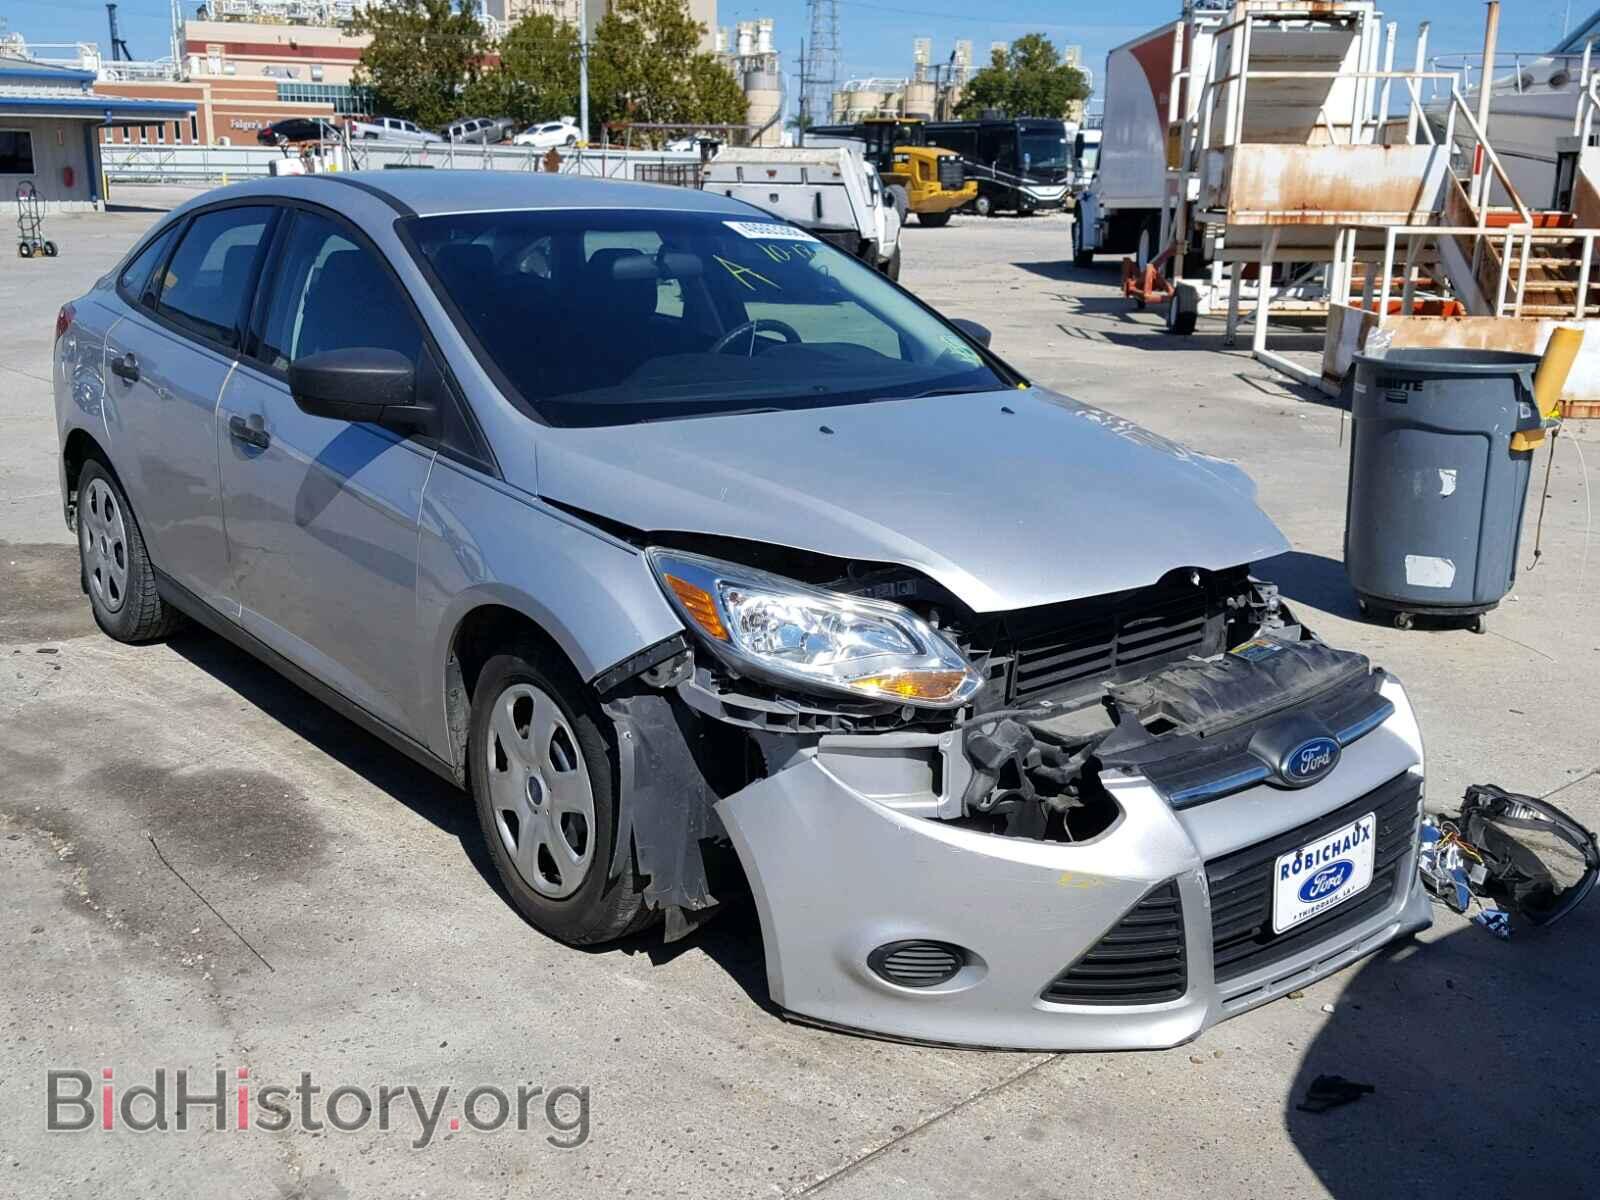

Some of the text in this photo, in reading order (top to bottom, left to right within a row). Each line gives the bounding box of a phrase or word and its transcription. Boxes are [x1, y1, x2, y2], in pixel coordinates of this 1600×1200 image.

[712, 253, 782, 291] A
[1301, 747, 1331, 774] Ford
[1280, 824, 1370, 880] ROBICHAUX
[1309, 867, 1344, 898] Ford
